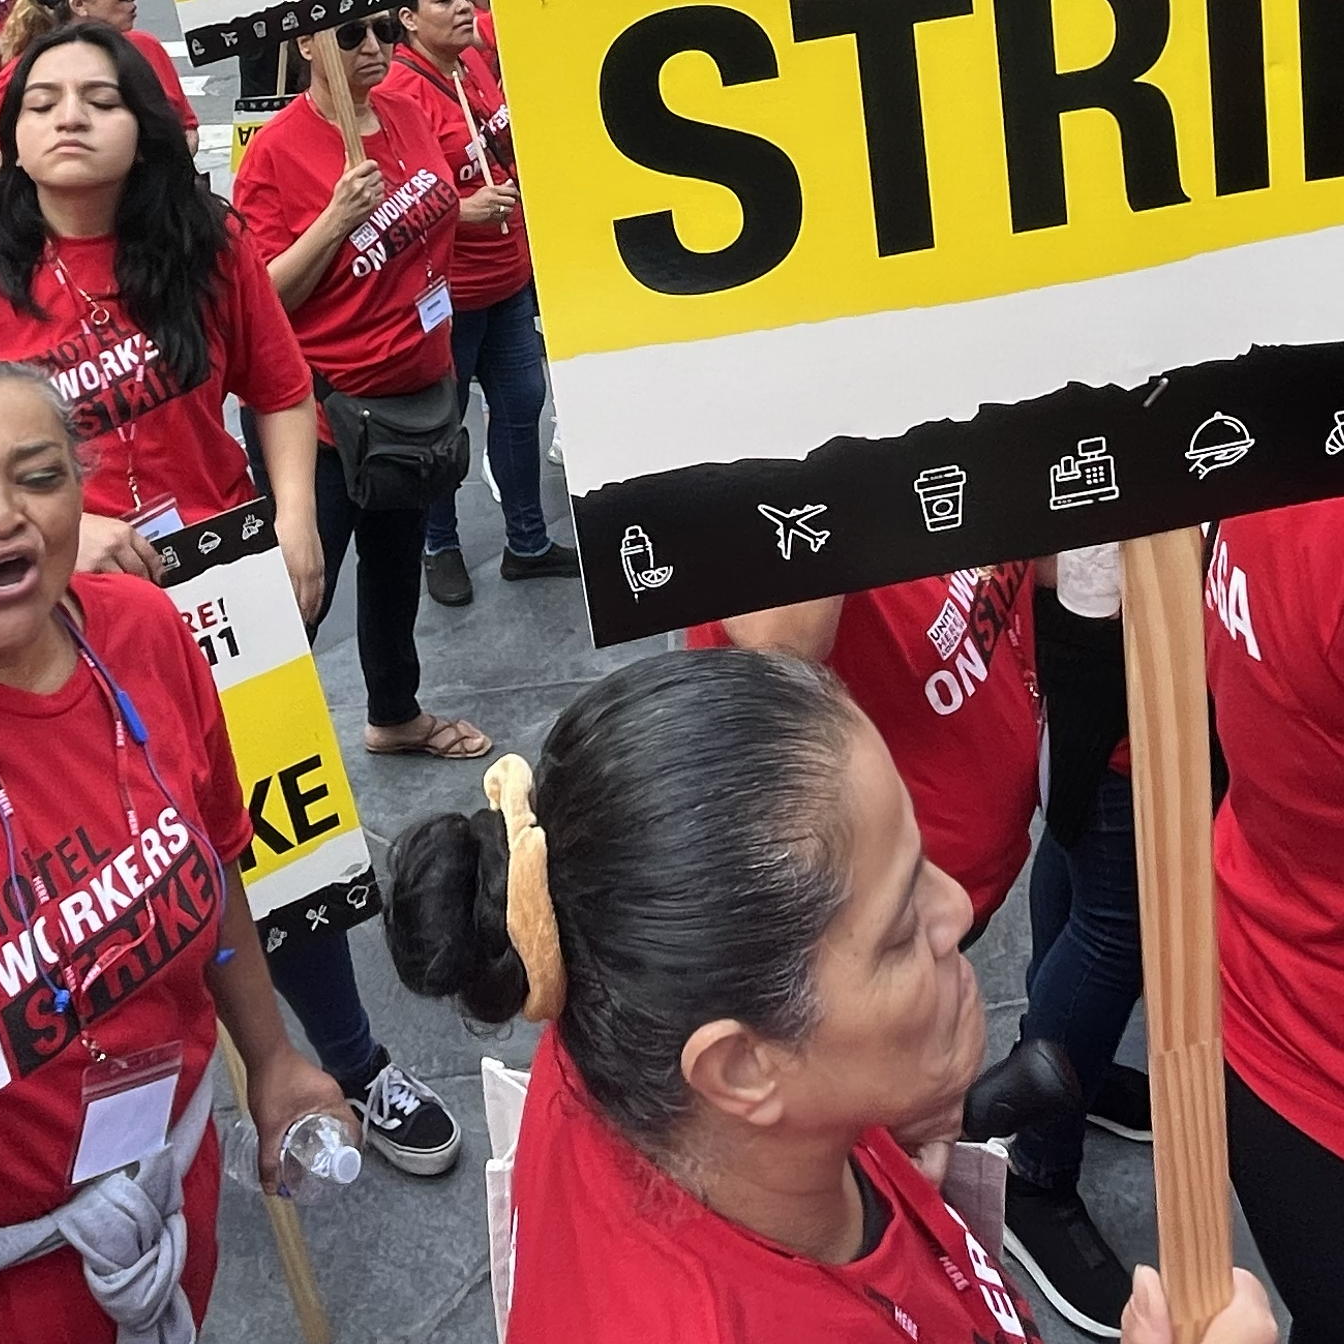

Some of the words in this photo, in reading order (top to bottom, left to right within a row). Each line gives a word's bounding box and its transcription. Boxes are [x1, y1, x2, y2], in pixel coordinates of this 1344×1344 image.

[351, 241, 388, 278] ON
[49, 333, 160, 402] WORK
[180, 597, 229, 633] RE!
[198, 626, 240, 667] 11
[924, 636, 989, 716] ON
[24, 853, 217, 1057] STRIKE
[894, 1305, 918, 1343] HERE
